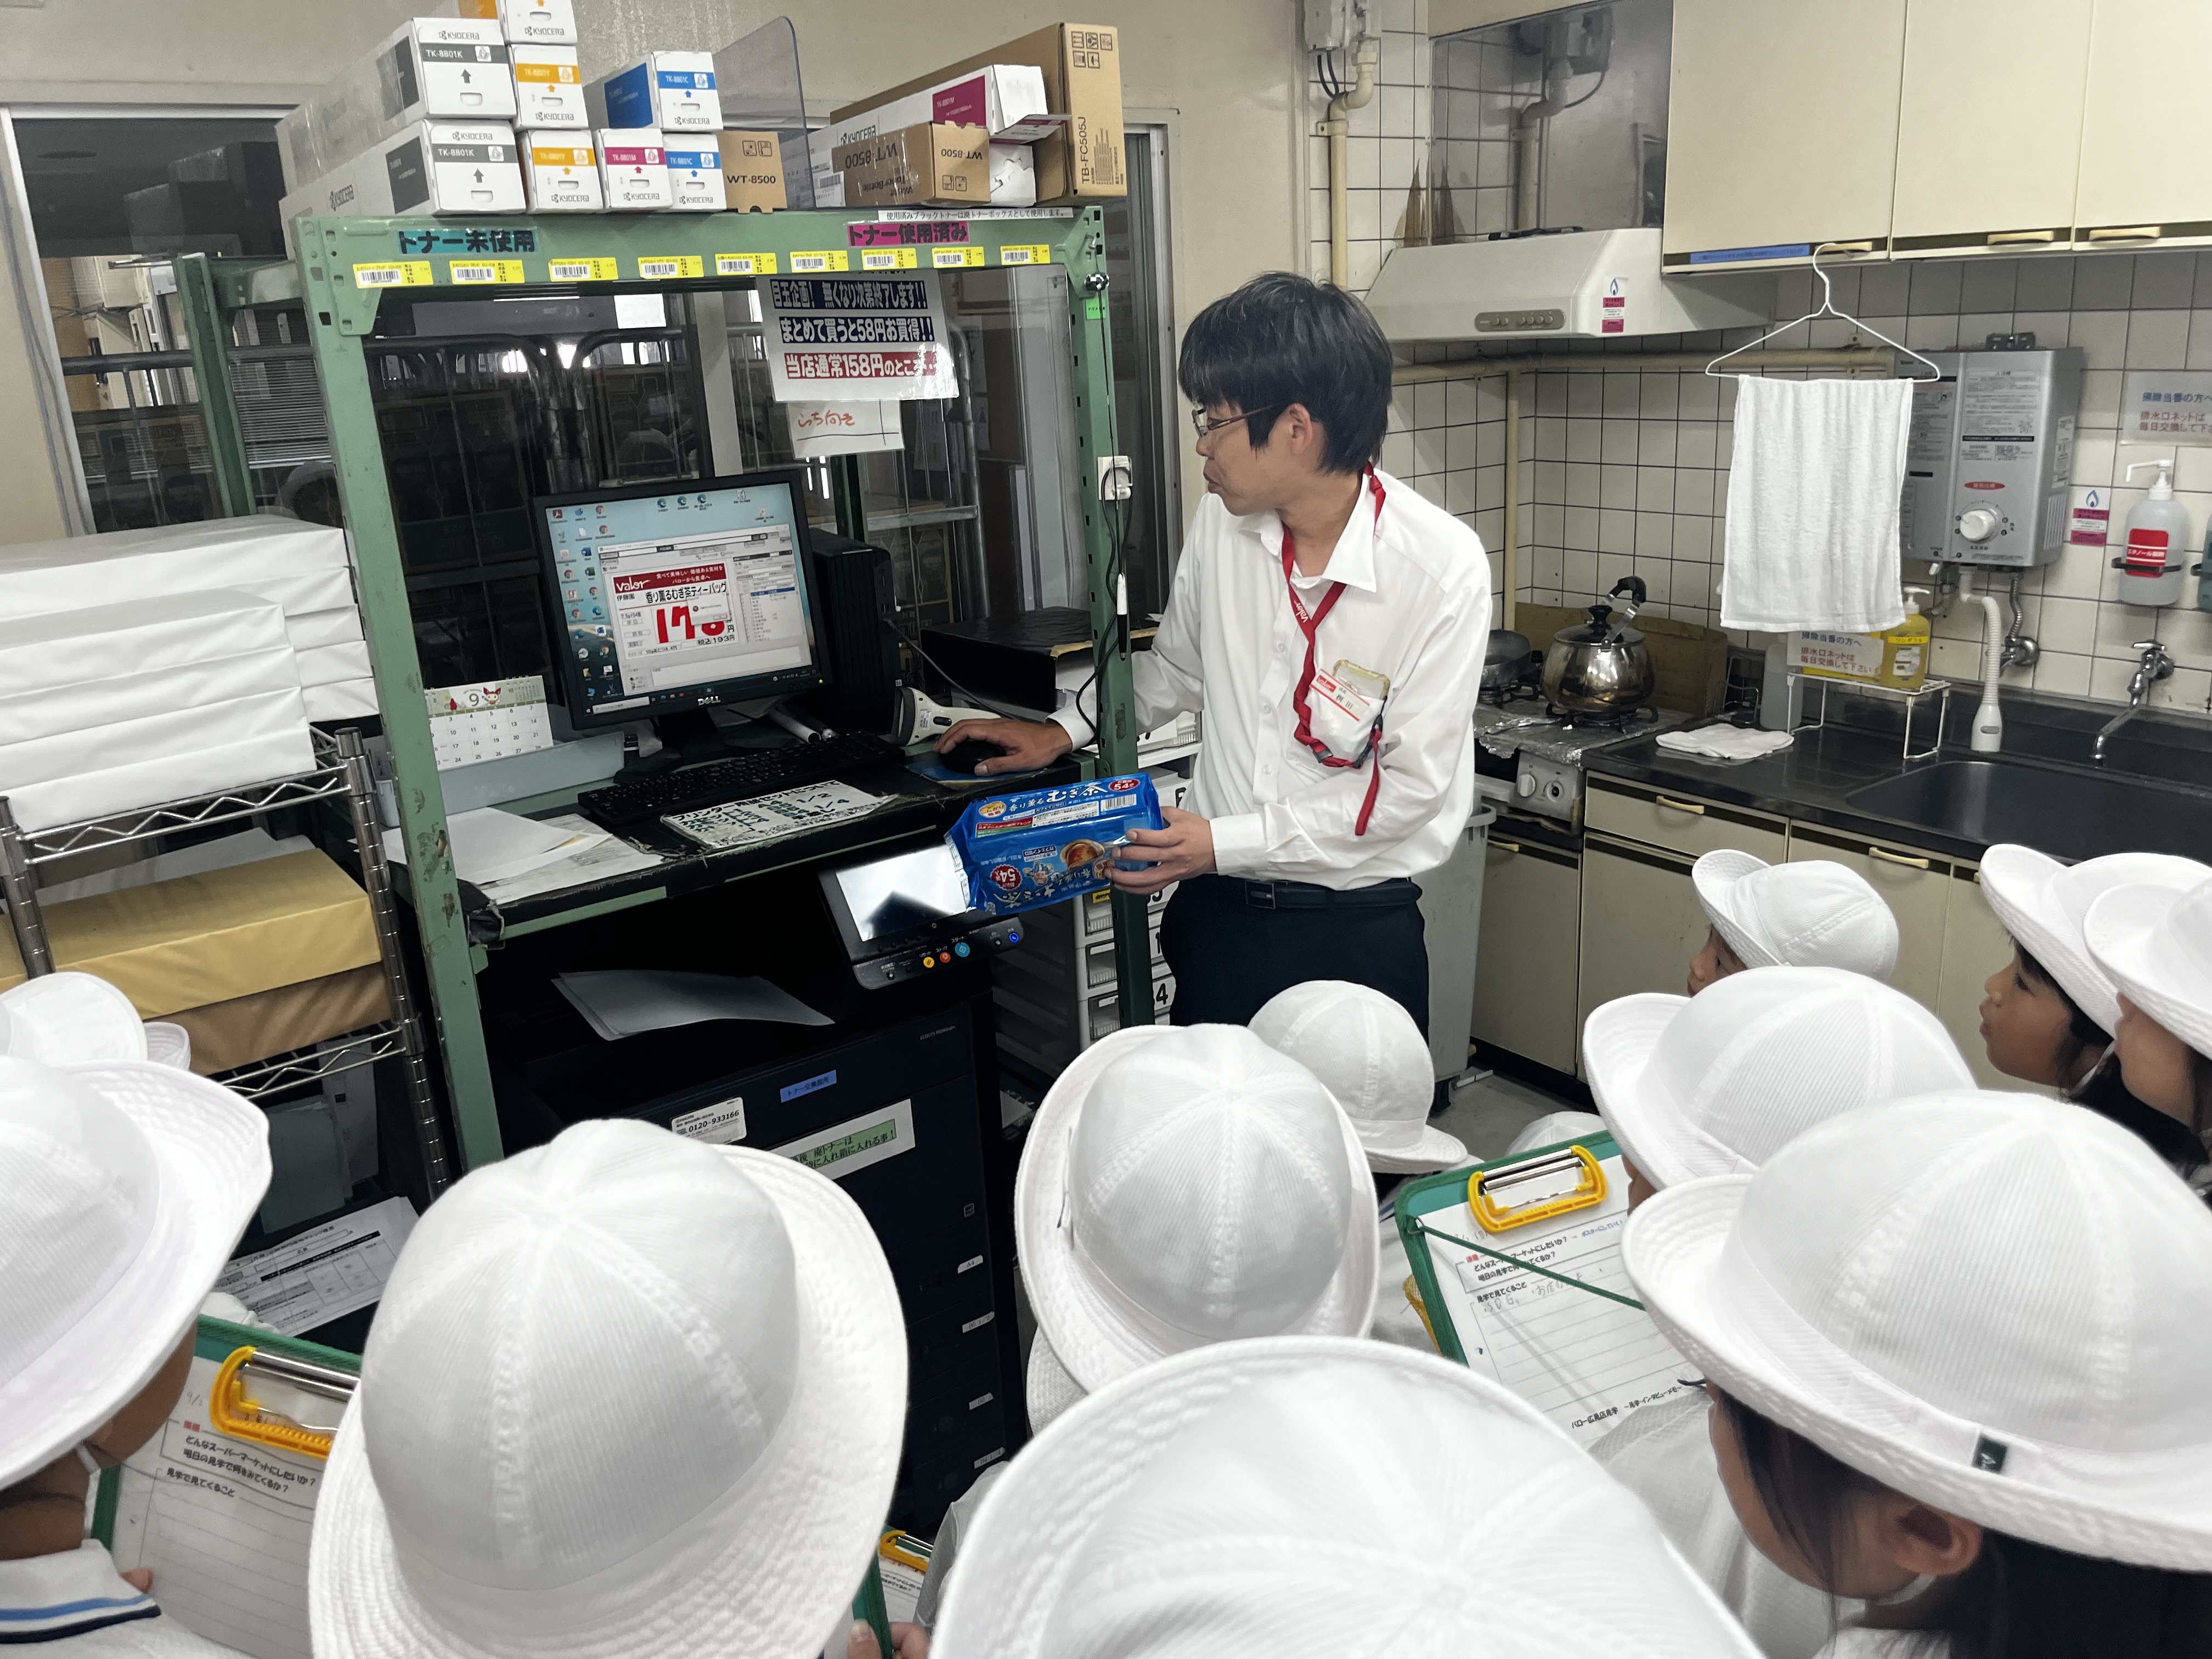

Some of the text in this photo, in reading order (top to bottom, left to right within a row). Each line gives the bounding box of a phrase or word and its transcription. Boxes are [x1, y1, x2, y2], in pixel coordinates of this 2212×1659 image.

[448, 31, 480, 40] KYOCERA
[533, 27, 565, 36] KYOCERA
[425, 49, 463, 59] TK-8801K
[1077, 116, 1090, 184] TB-FC505J
[399, 230, 535, 254] トナー未使用
[850, 222, 967, 246] トナー使用済み
[616, 577, 651, 592] valor
[1801, 647, 1855, 662] 排水口ネットは
[469, 693, 479, 707] 9
[697, 696, 721, 707] DELL
[1046, 782, 1108, 803] むぎ茶
[689, 1110, 740, 1132] 0120-933166
[1477, 1282, 1527, 1304] 見学で見てくること
[167, 1466, 235, 1498] 見学で見てくること
